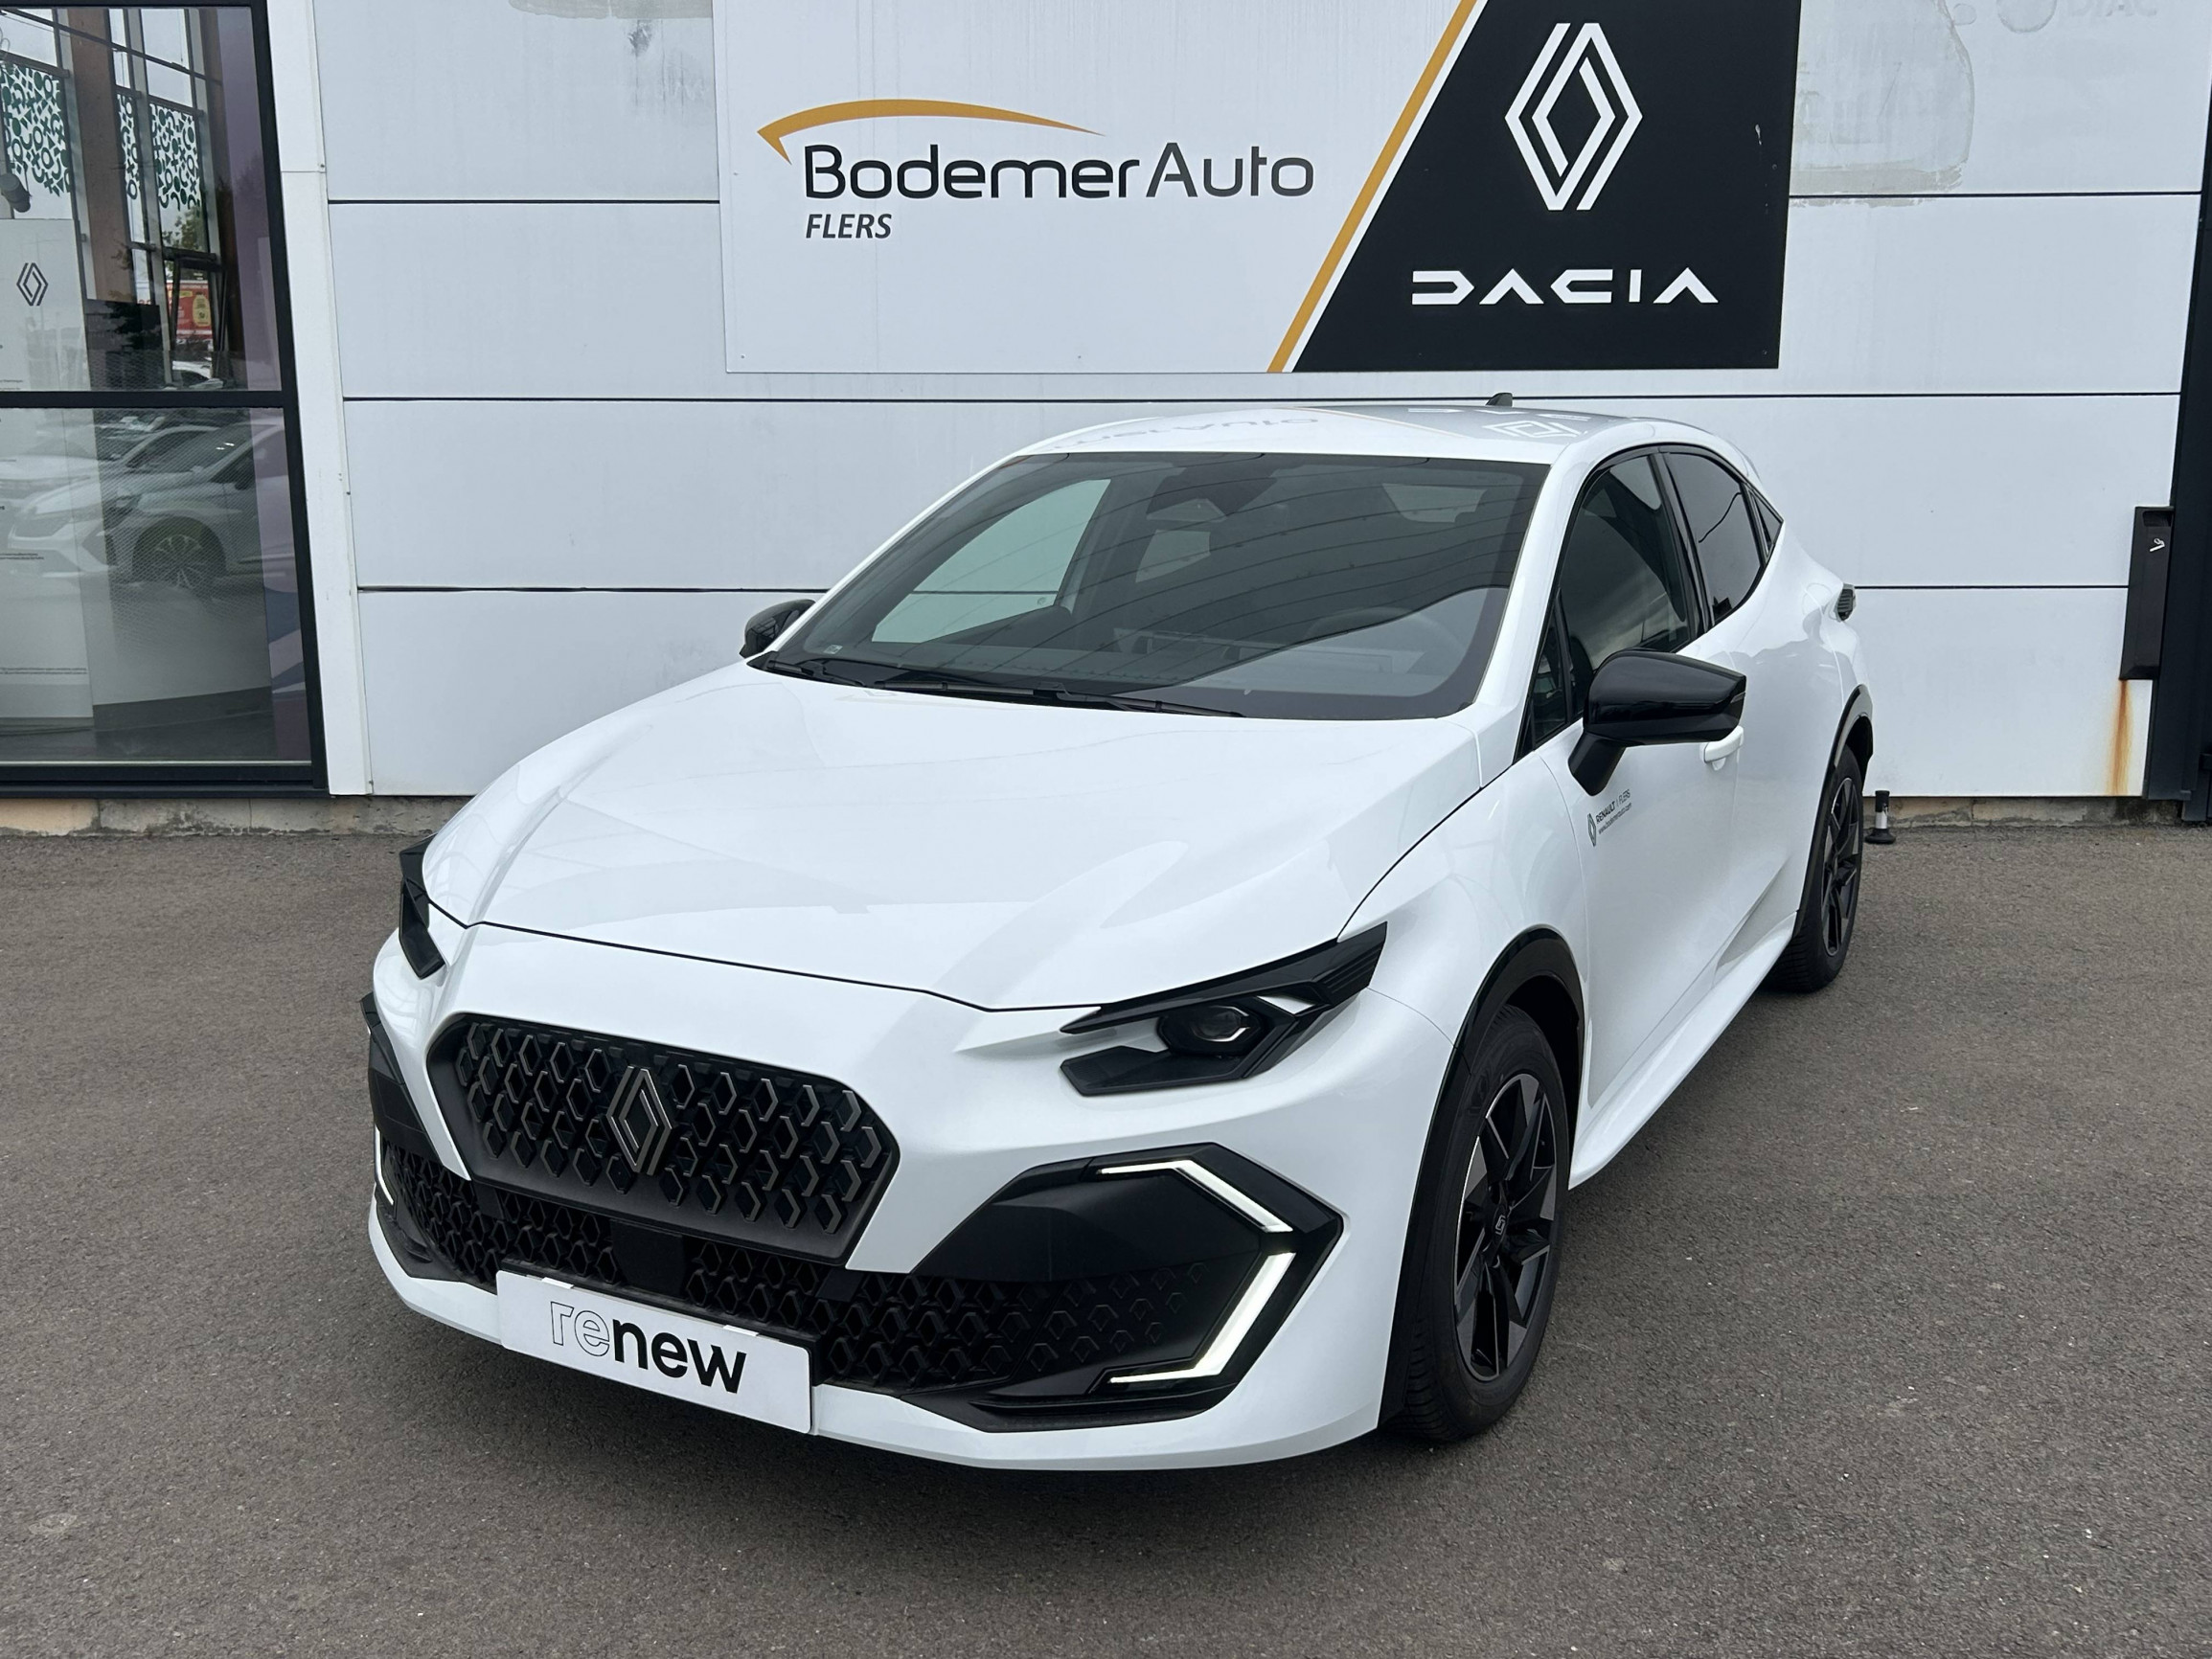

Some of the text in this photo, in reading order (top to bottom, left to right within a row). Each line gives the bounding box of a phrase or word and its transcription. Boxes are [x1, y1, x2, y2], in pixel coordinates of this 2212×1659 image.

[806, 213, 892, 239] FLERS
[1412, 267, 1719, 306] DACIA
[1595, 801, 1616, 824] RENAULT
[550, 1301, 747, 1394] renew
